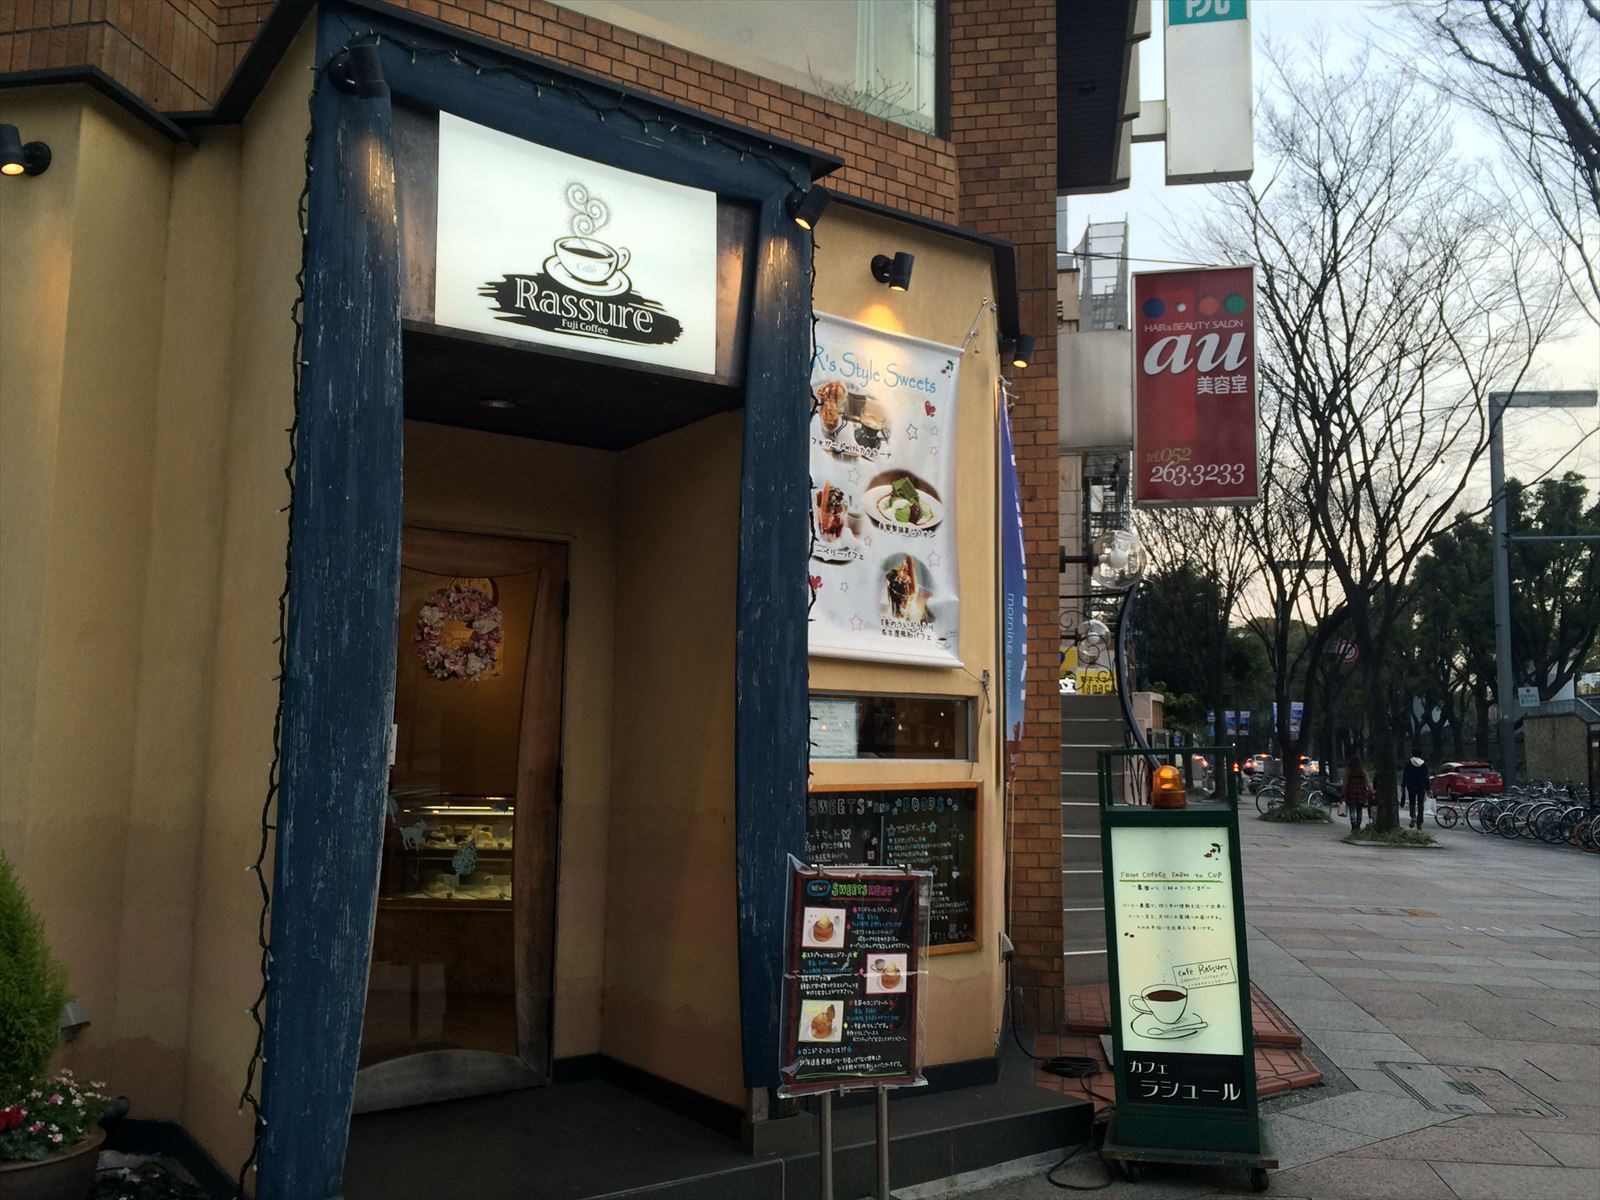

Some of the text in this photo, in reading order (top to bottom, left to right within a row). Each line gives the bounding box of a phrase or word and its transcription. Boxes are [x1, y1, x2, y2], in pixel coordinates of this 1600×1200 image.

[514, 277, 654, 334] Rassure
[561, 318, 609, 336] Fuji Coffee
[1213, 320, 1244, 329] SALON
[1143, 333, 1248, 375] au
[839, 352, 881, 388] Style
[884, 363, 937, 394] Sweets
[1197, 374, 1248, 395] 美容室
[808, 798, 865, 816] SWEETS
[903, 797, 944, 813] FOODS
[832, 882, 868, 897] SWEETS
[1130, 1060, 1168, 1075] カフェ
[1140, 1079, 1241, 1101] ラシュール
